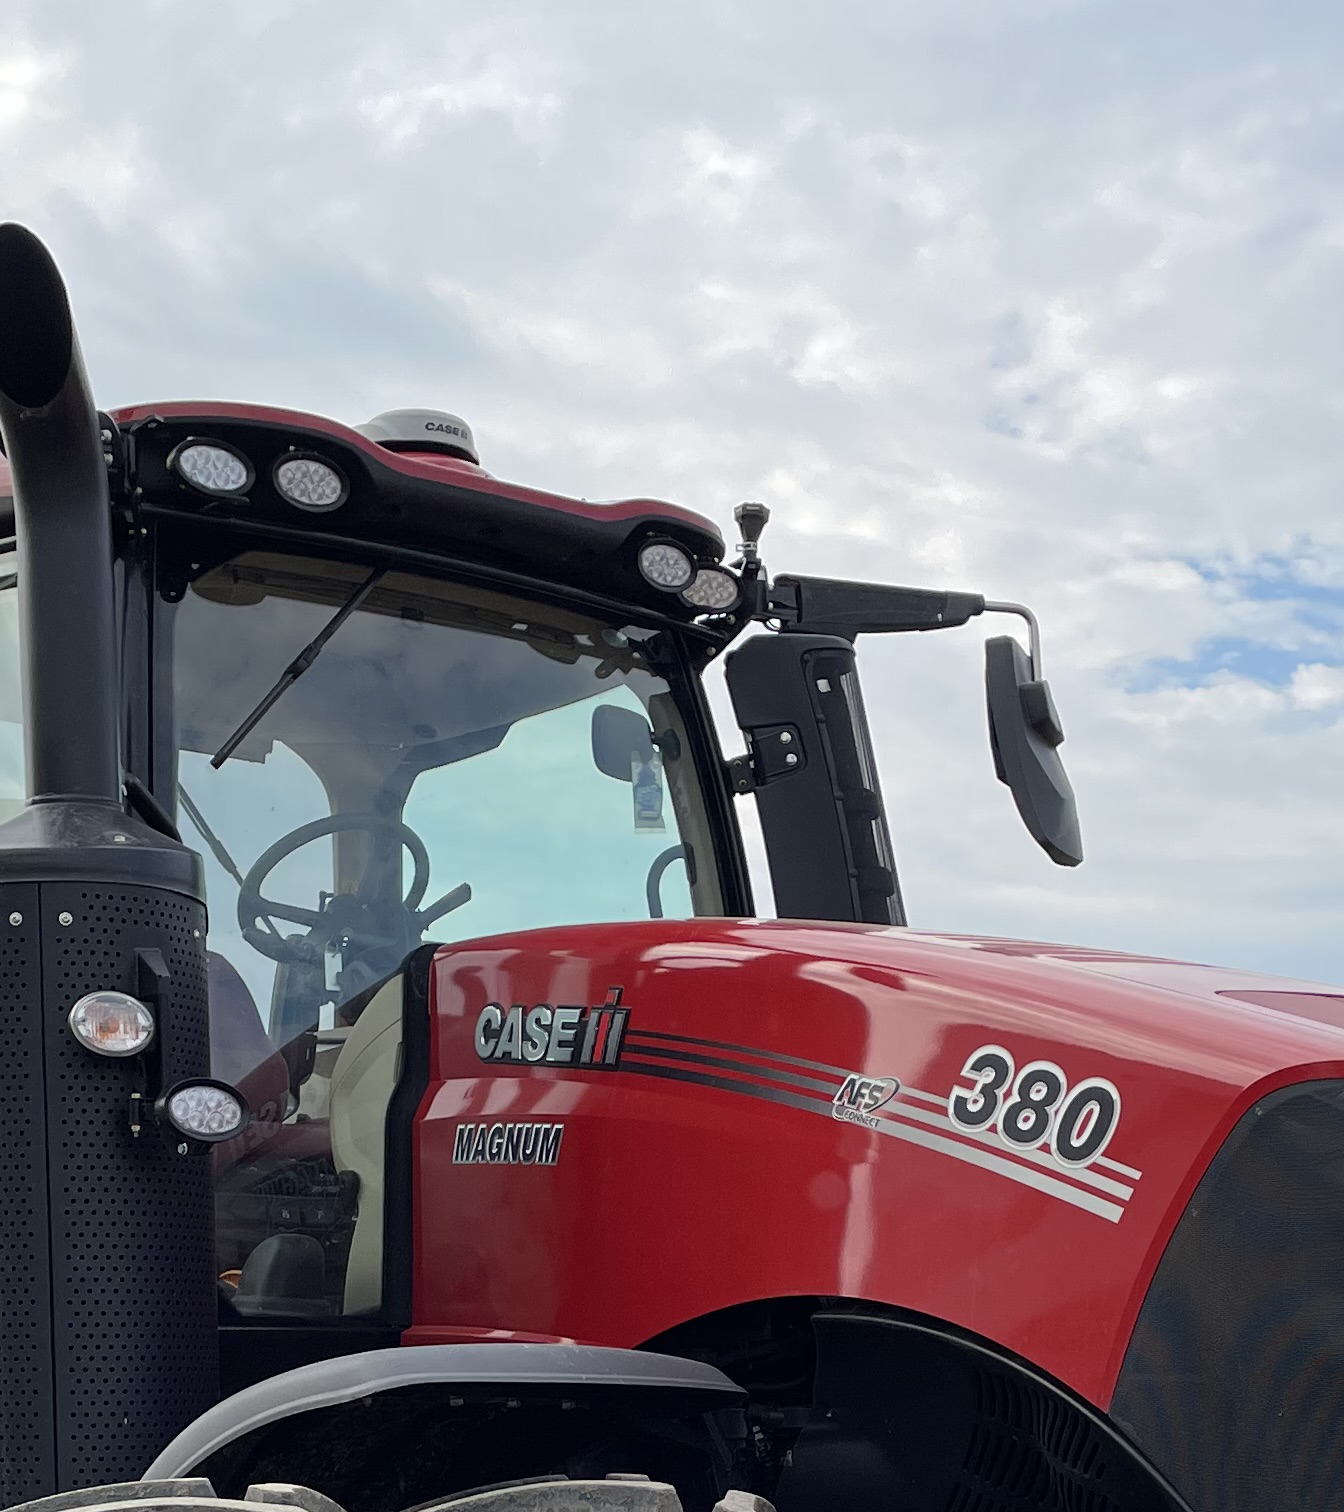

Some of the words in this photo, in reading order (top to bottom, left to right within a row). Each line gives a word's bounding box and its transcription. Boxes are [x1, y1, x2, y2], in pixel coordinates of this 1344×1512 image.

[425, 422, 460, 436] CASE
[474, 1003, 586, 1065] CASE
[833, 1074, 887, 1113] AFS
[948, 1044, 1122, 1169] 380
[843, 1109, 881, 1128] CONNECT
[452, 1122, 565, 1166] MAGNUM
